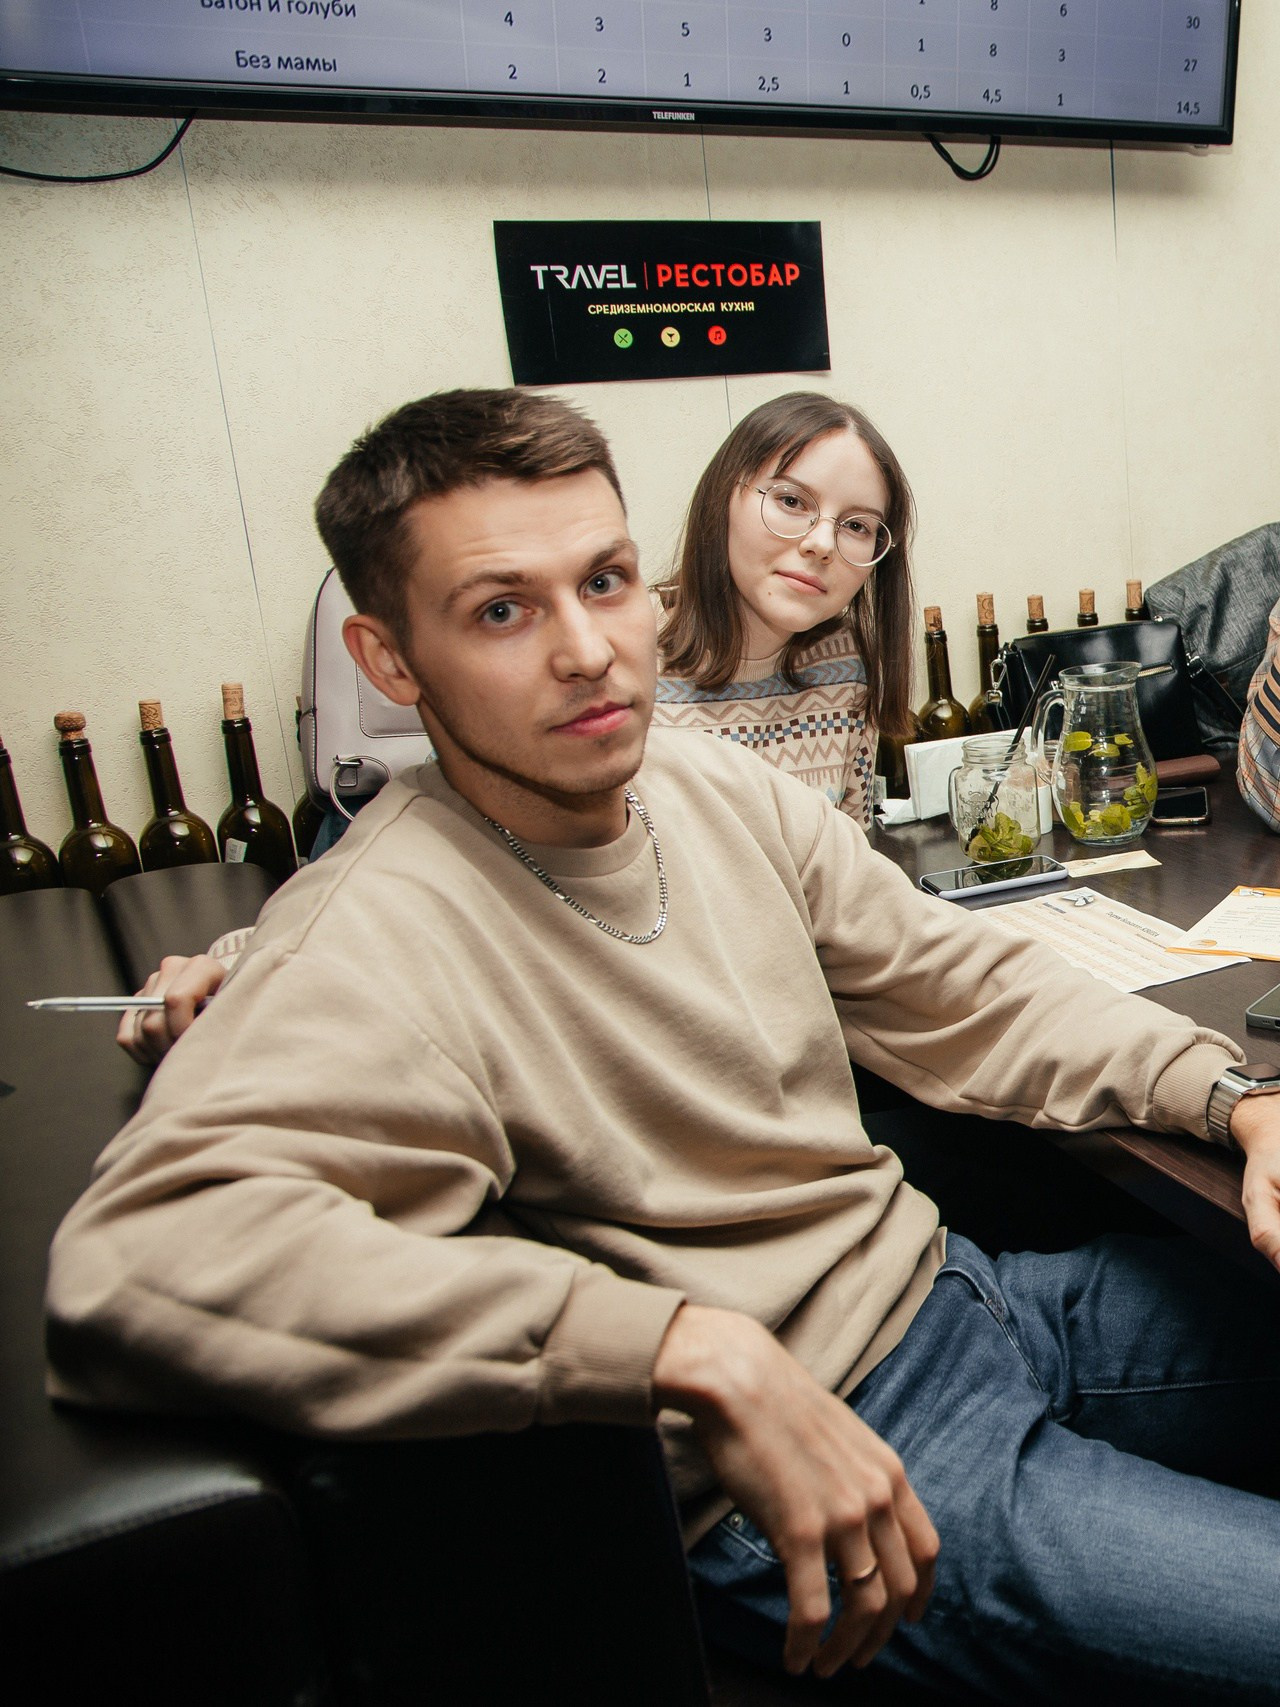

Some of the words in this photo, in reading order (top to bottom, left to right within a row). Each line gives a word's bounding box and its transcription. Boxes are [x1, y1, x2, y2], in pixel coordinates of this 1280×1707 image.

[1059, 4, 1068, 17] 6
[1185, 16, 1200, 30] 30
[268, 0, 281, 13] и
[287, 0, 357, 20] голуби
[504, 11, 514, 27] 4
[594, 16, 604, 32] 3
[681, 22, 690, 37] 5
[763, 27, 772, 42] 3
[841, 32, 851, 47] 0
[918, 38, 925, 52] 1
[989, 44, 997, 57] 8
[1058, 49, 1066, 62] 3
[1183, 58, 1198, 72] 27
[235, 50, 271, 69] Без
[277, 55, 338, 73] мамы
[507, 64, 517, 80] 2
[597, 68, 607, 84] 2
[683, 72, 692, 87] 1
[757, 76, 780, 93] 2,5
[843, 81, 851, 95] 1
[910, 84, 931, 101] 0,5
[982, 89, 1002, 104] 4,5
[1057, 93, 1064, 107] 1
[1176, 101, 1200, 116] 14,5
[652, 111, 695, 121] TELEFUNKEN
[530, 264, 637, 290] TRAVEL
[656, 262, 801, 288] РЕСТОБАР
[587, 302, 715, 316] СРЕДИЗЕМНОМОРСКАЯ
[720, 301, 755, 313] КУХНЯ
